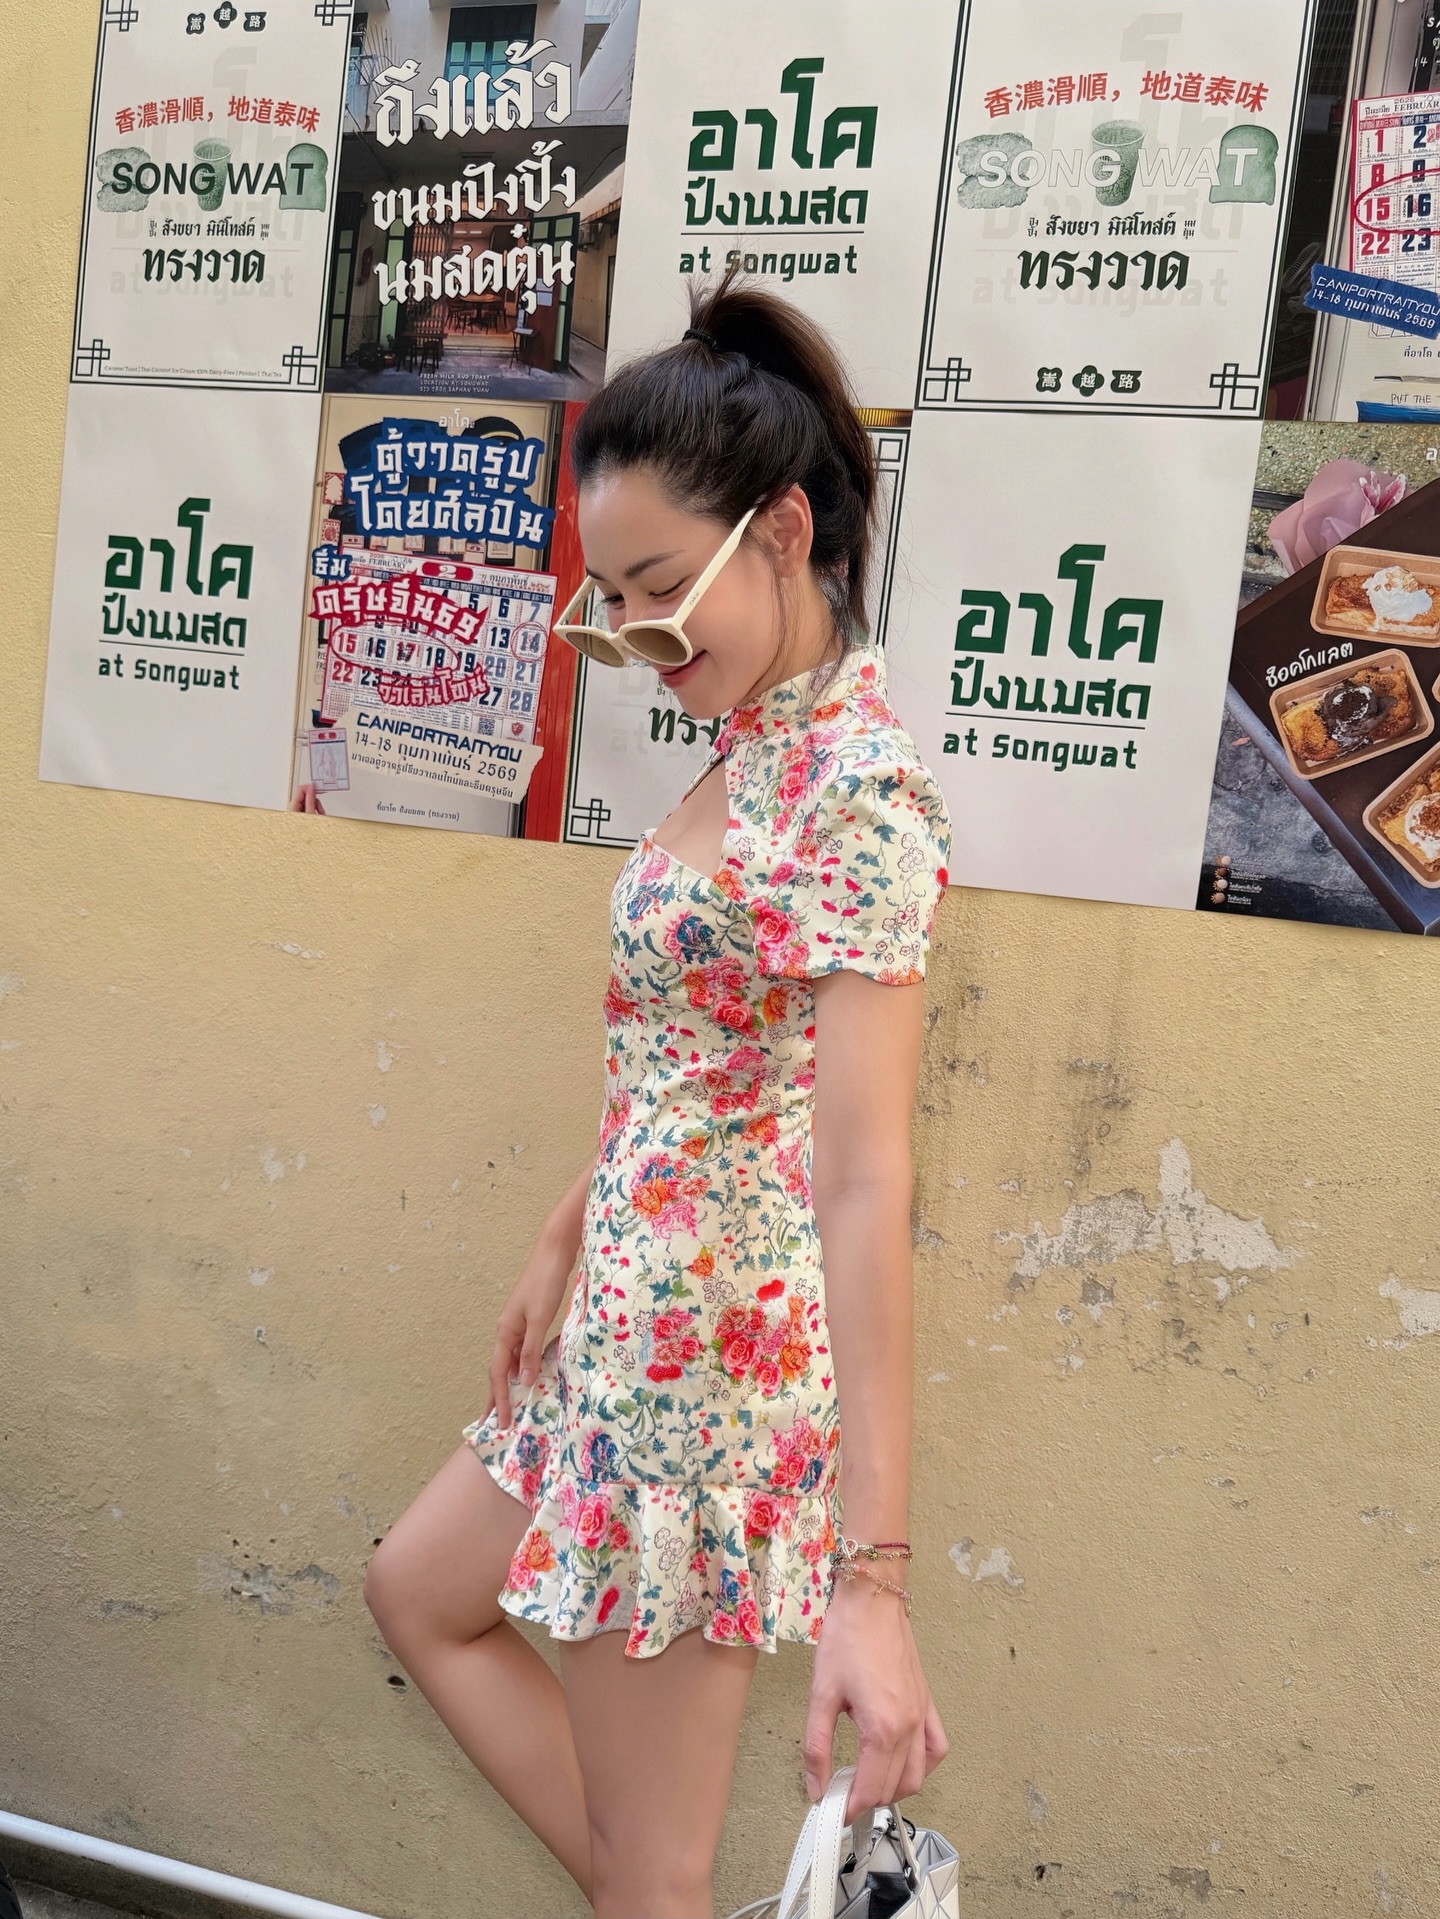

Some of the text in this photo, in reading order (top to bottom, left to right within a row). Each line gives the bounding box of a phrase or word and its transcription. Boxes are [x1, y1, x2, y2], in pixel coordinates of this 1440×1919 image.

[373, 39, 572, 148] ถึงแล้ว
[688, 57, 878, 171] อาโค
[1375, 125, 1427, 153] 1 2
[112, 163, 313, 195] SONG WAT
[371, 139, 576, 231] ขนมปังปิ้ง
[977, 148, 1259, 187] SONG WAT
[1371, 159, 1425, 188] 8 9
[684, 176, 868, 225] ปังนมสด
[1364, 193, 1431, 222] 15 16
[162, 217, 200, 236] สังขยา
[1046, 211, 1176, 236] สังขยา มินิโทสต์
[1361, 228, 1431, 256] 22 23
[143, 249, 266, 284] ทรงวาด
[374, 223, 575, 315] นมสดตุ๋น
[679, 246, 711, 274] at
[1017, 250, 1190, 291] ทรงวาด
[1312, 289, 1436, 329] 14-18 กุมภาพันธ์ 2569
[1316, 276, 1440, 317] CANIPORTRAITYOU
[439, 408, 470, 428] อาโค
[1391, 394, 1431, 406] PUT THE
[376, 428, 536, 488] ตู้วาดรูป
[351, 473, 544, 542] โดยศิลปิน
[105, 497, 254, 600] อาโค
[314, 549, 346, 578] ธีม
[368, 558, 407, 569] FEBRUARY
[439, 564, 457, 579] 2
[102, 592, 247, 648] ปังนมสด
[498, 598, 510, 618] 6
[529, 603, 541, 622] 7
[954, 544, 1164, 664] อาโค
[338, 632, 357, 654] 15
[367, 635, 386, 658] 16
[427, 647, 446, 668] 18
[457, 651, 475, 673] 19
[485, 656, 506, 678] 20
[515, 660, 536, 683] 21
[491, 627, 511, 648] 13
[520, 631, 540, 654] 14
[99, 653, 239, 691] at Songwat
[332, 660, 353, 682] 22
[361, 669, 382, 687] 23
[479, 687, 503, 707] 27
[509, 690, 533, 713] 28
[951, 656, 1151, 720] ปังนมสด
[355, 731, 517, 782] 14-18 กุมภาพันธ์ 2569
[357, 712, 522, 763] CANIPORTRAITYOU
[943, 728, 1137, 772] at Songwat
